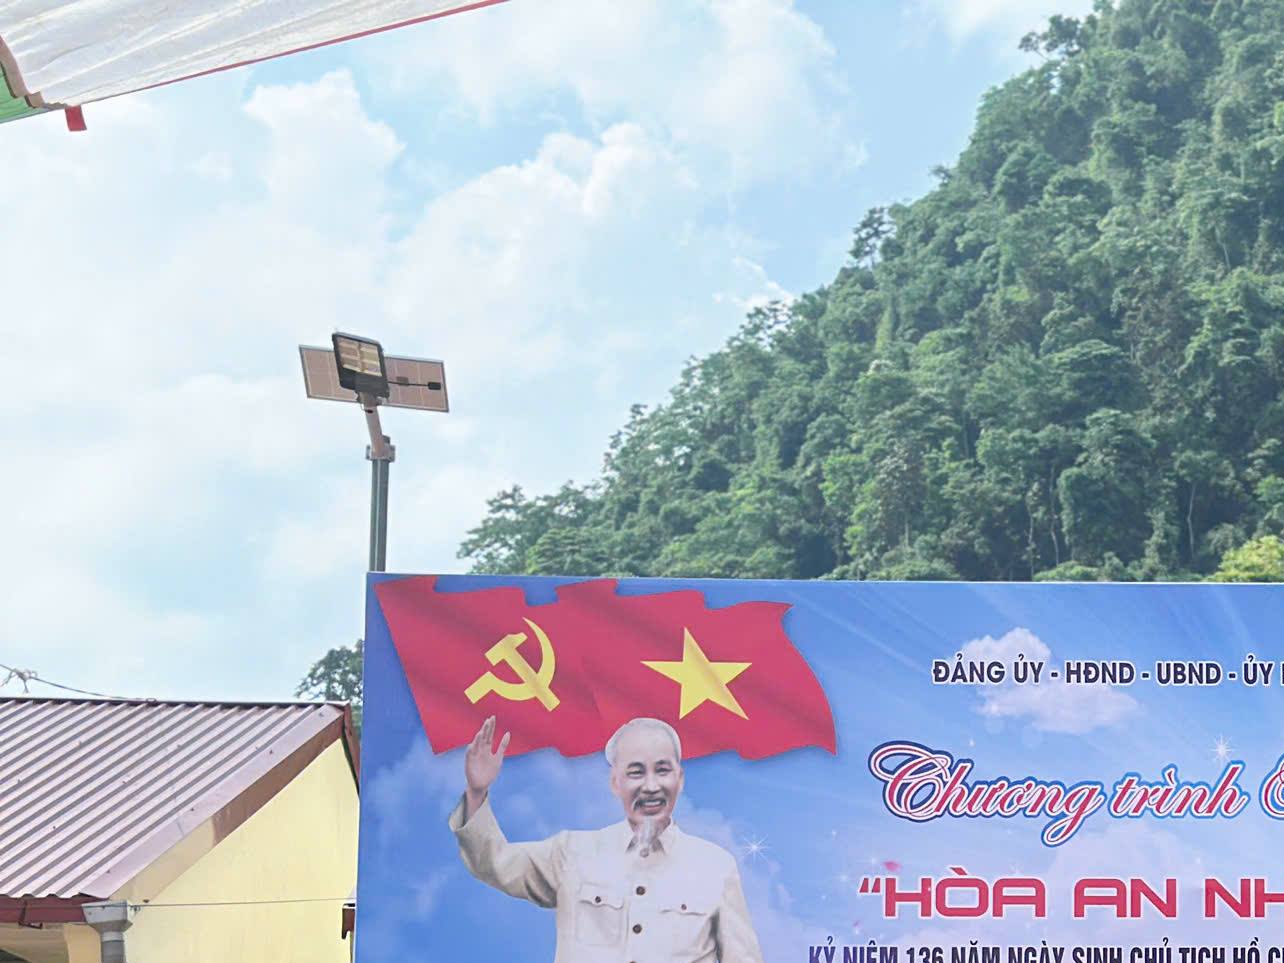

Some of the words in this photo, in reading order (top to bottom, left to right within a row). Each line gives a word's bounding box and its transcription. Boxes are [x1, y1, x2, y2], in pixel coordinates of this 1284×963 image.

[933, 653, 1005, 684] ĐẢNG
[1013, 653, 1044, 684] ỦY
[1065, 660, 1135, 684] HĐND
[1156, 661, 1221, 685] UBND
[1243, 655, 1273, 686] ỦY
[868, 741, 1106, 846] Chương
[1108, 760, 1250, 819] trình
[1073, 877, 1177, 918] AN
